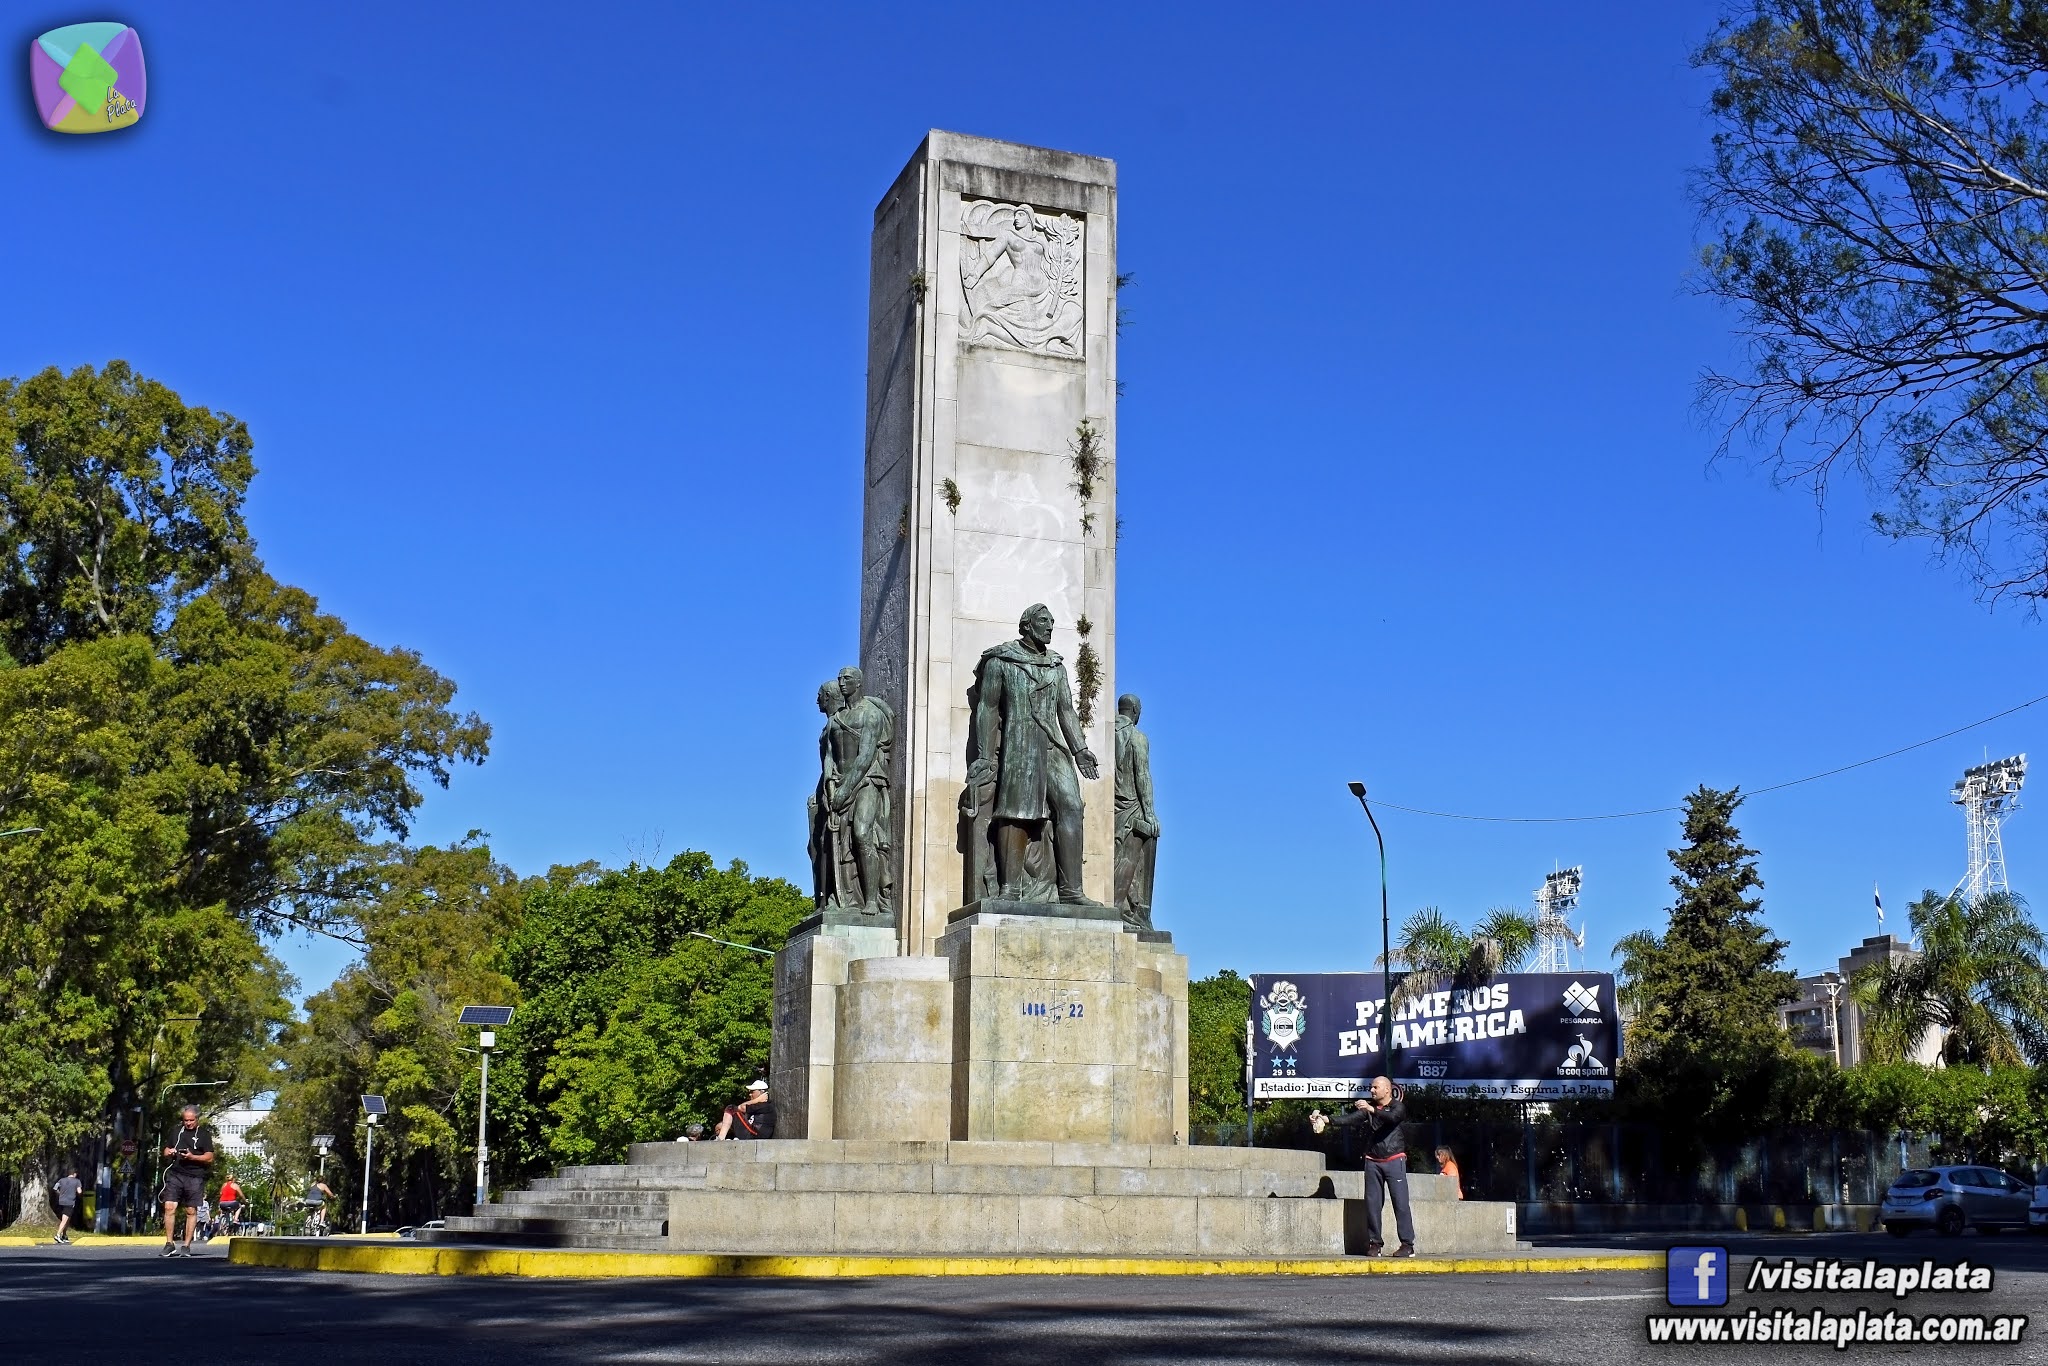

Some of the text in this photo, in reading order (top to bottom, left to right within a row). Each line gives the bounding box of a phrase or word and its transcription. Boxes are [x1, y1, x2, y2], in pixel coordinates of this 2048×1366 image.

[1069, 1003, 1084, 1018] 22
[1338, 1009, 1527, 1056] EN AMERICA
[1417, 1065, 1448, 1077] 1887
[1556, 1067, 1608, 1077] le coq sportif
[1260, 1082, 1304, 1092] Estadio:
[1306, 1083, 1332, 1093] Juan
[1335, 1083, 1346, 1092] C.
[1500, 1086, 1507, 1096] y
[1561, 1085, 1575, 1094] La
